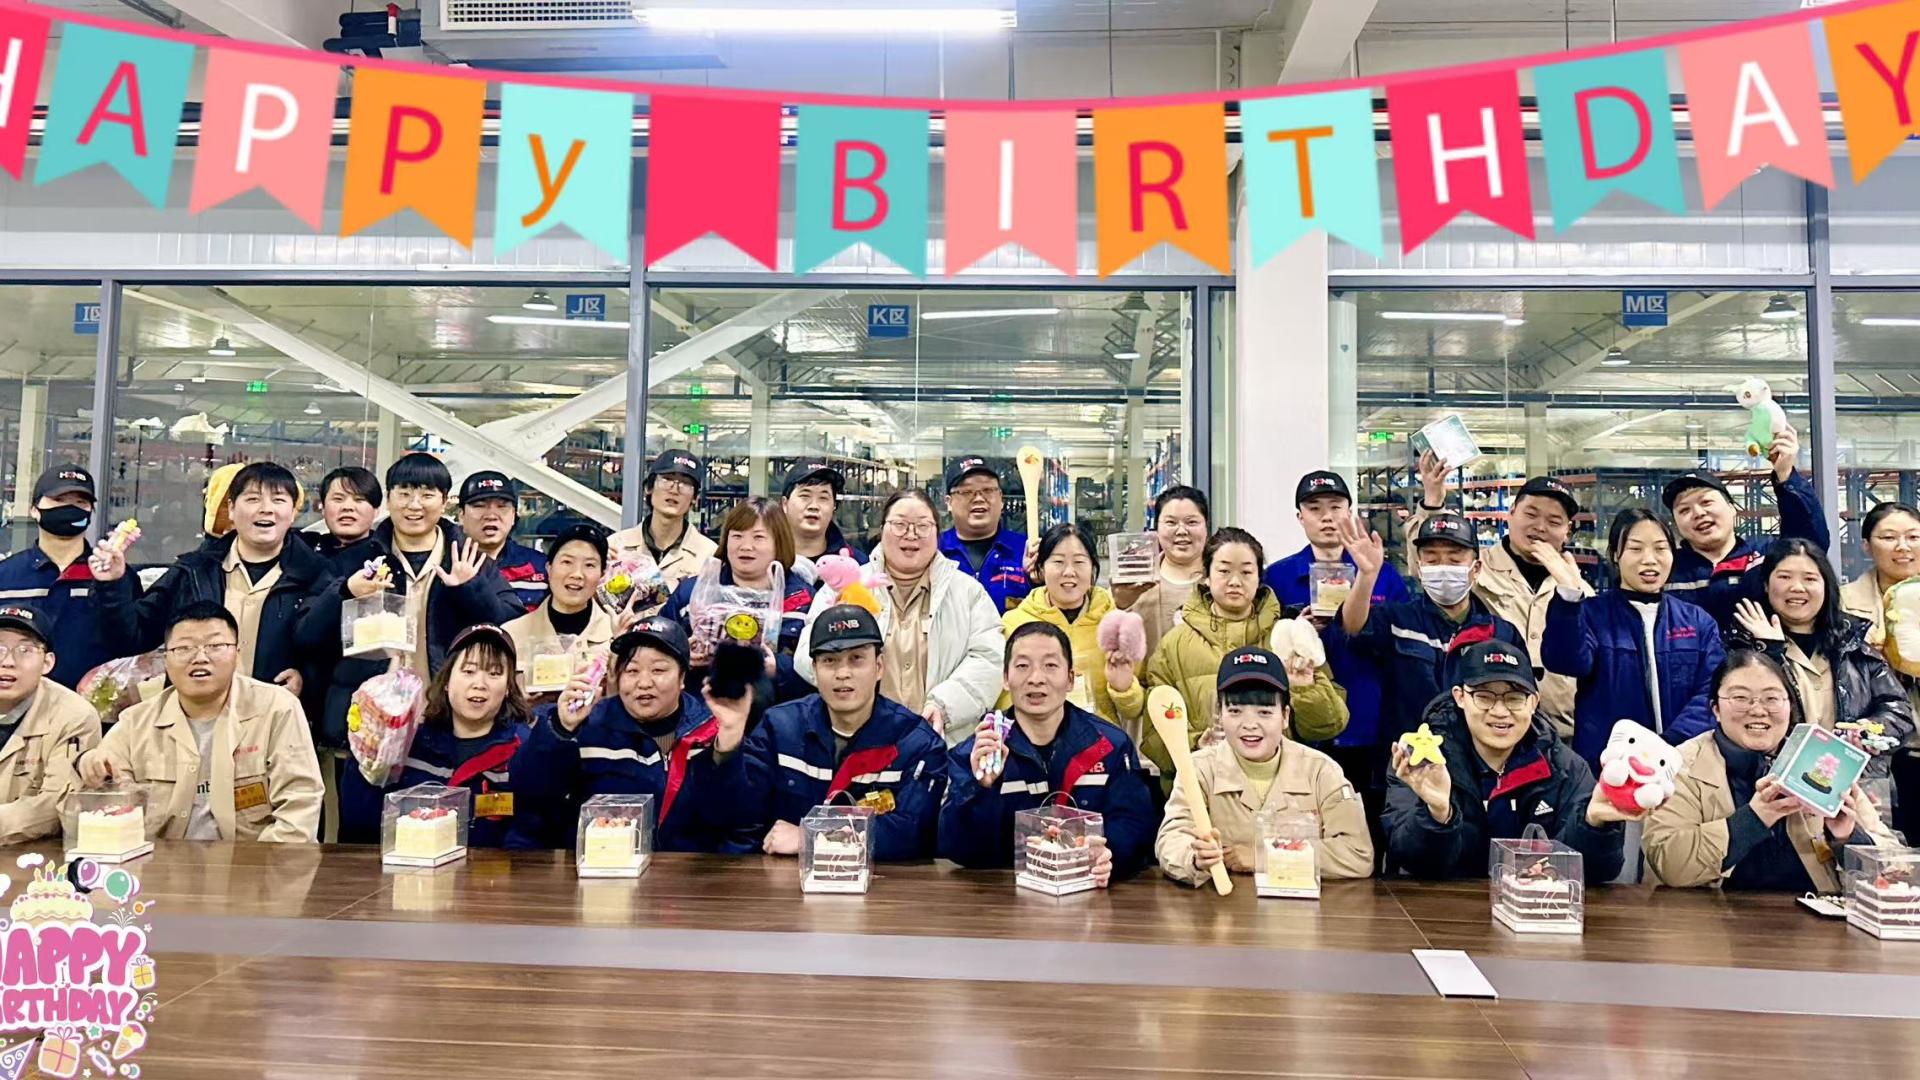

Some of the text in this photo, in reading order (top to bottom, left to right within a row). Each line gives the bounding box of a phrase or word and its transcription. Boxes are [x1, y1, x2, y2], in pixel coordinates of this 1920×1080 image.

[570, 297, 601, 314] J区
[1626, 295, 1665, 312] M区
[873, 308, 906, 324] K区
